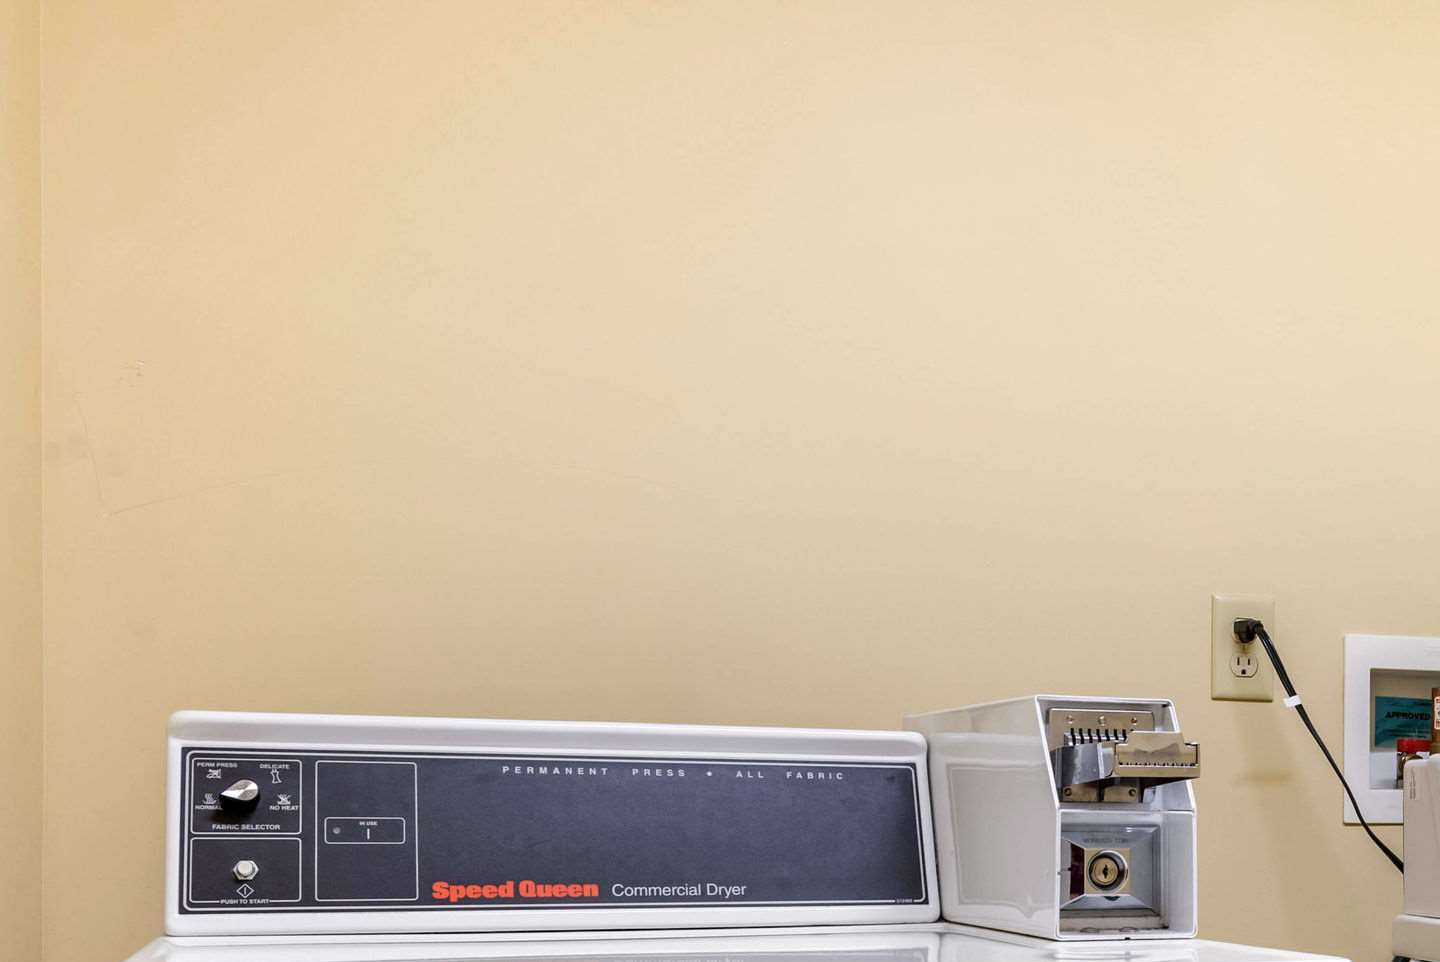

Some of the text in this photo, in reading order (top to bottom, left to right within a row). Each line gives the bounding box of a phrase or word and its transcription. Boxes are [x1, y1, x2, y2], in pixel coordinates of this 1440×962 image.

[1385, 711, 1431, 721] APPROVED
[501, 765, 845, 780] PERMANENT PRESS ALL FABRIC
[431, 880, 747, 903] Speed Queen Commercial Dryer
